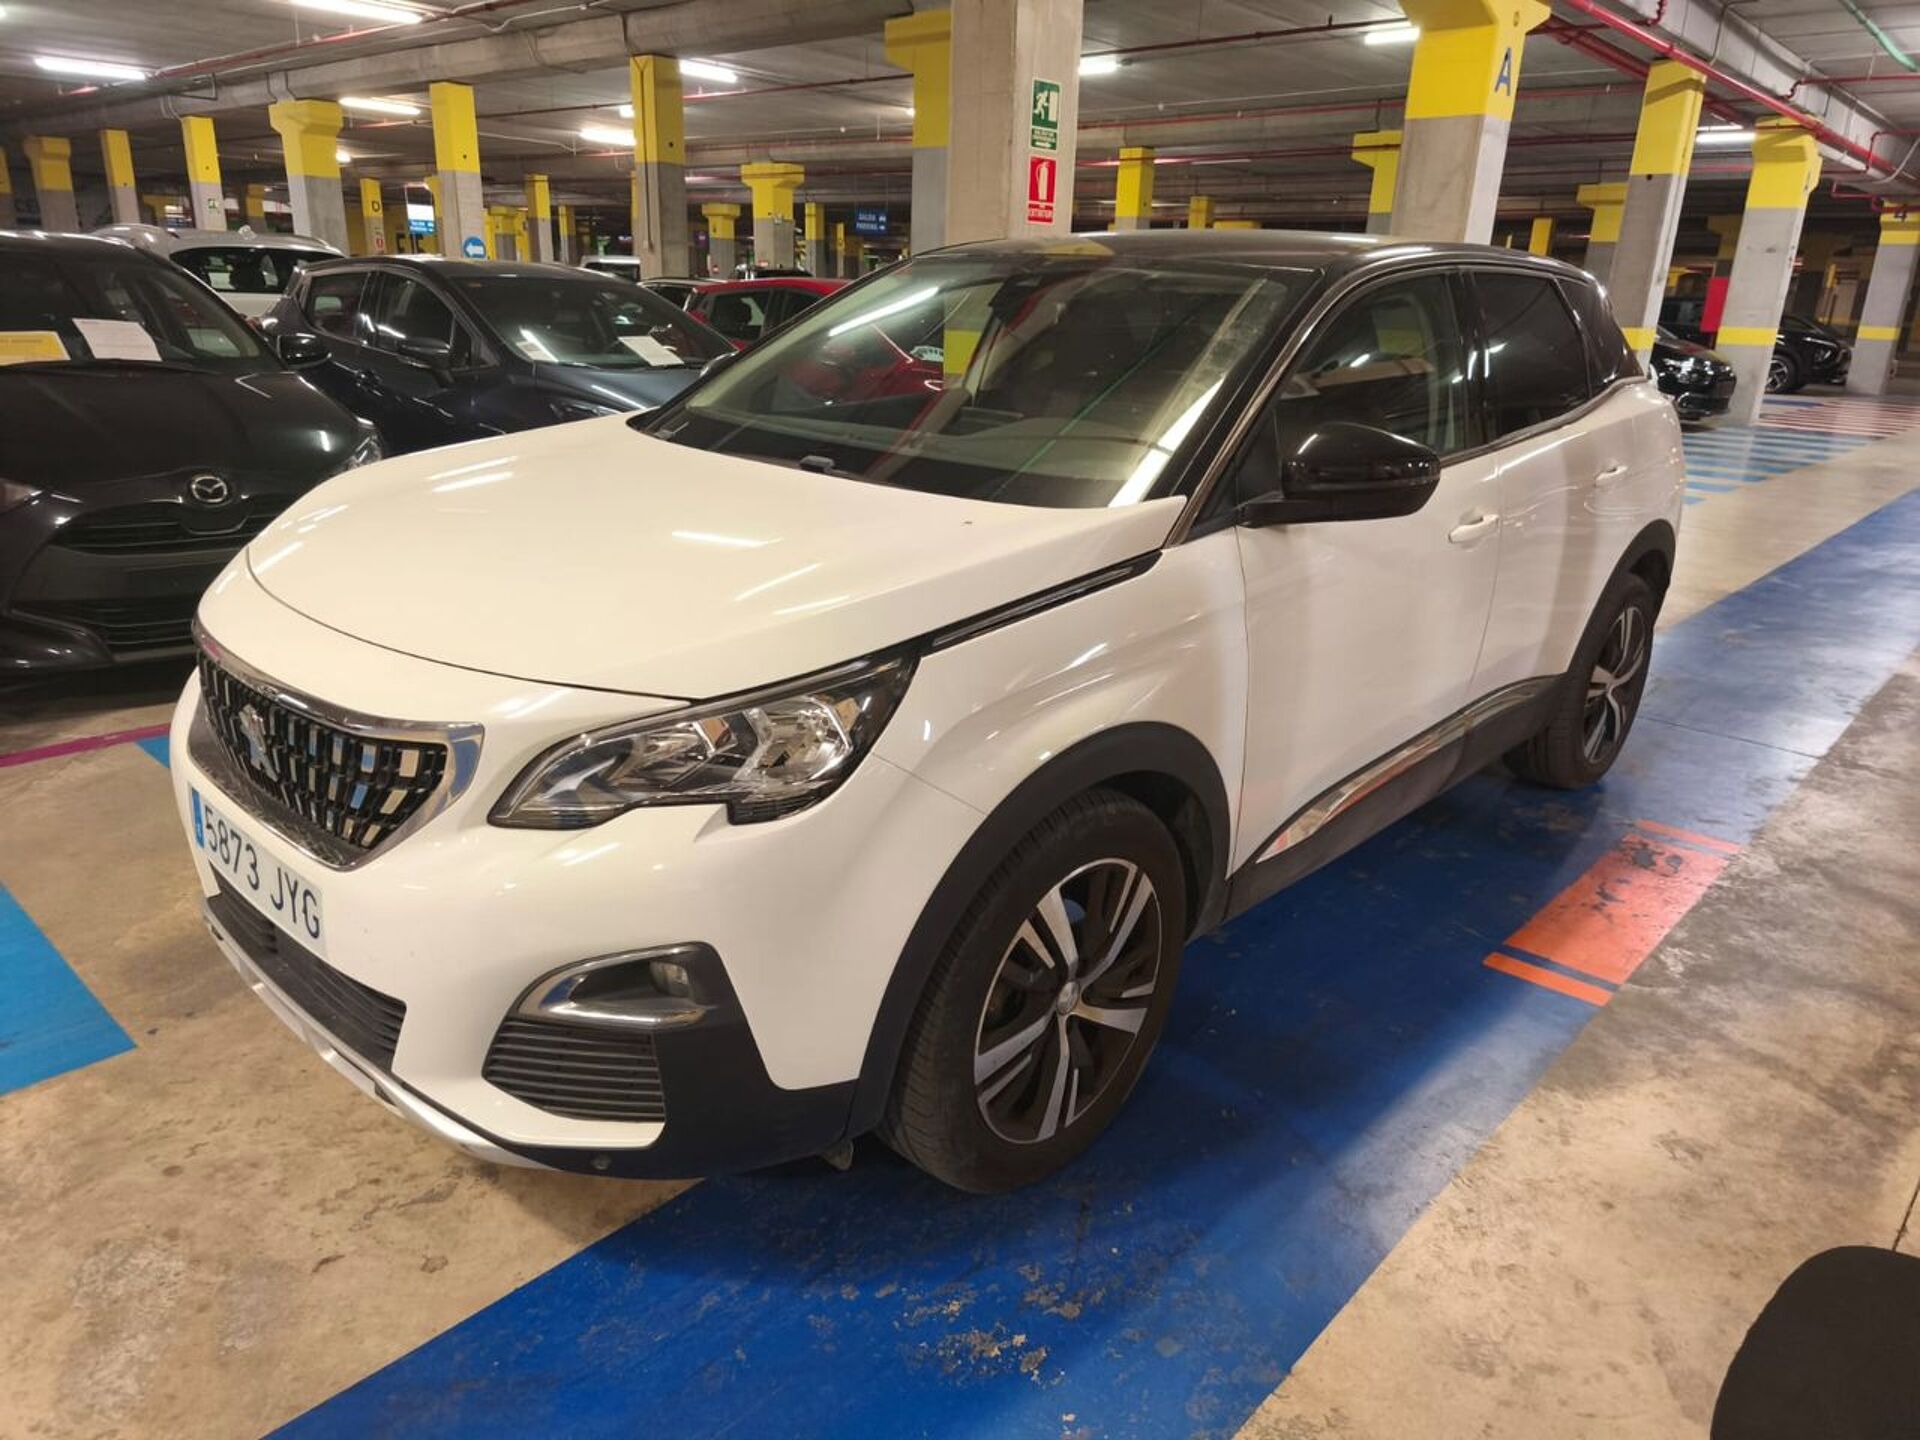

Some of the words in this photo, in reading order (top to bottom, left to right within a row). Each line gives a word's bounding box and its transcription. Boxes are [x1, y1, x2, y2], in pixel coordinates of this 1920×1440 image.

[1494, 47, 1511, 96] A
[205, 805, 260, 890] 5873
[270, 867, 320, 939] JYG
